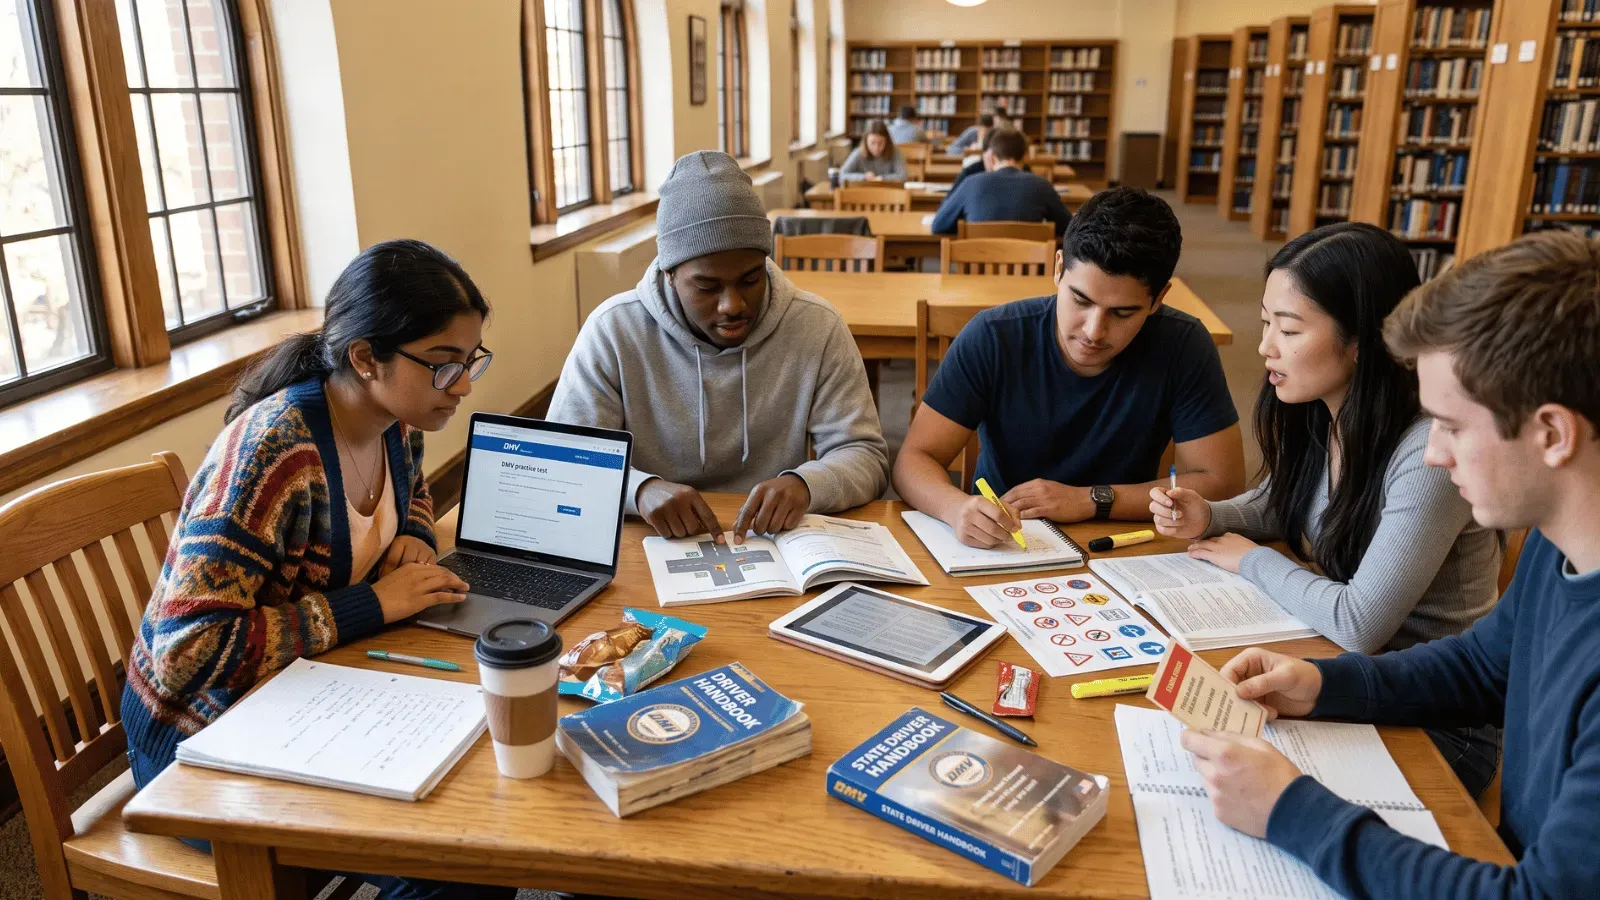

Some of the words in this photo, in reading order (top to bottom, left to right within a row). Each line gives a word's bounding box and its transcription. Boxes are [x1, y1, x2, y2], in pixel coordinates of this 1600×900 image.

[503, 442, 521, 451] DMV
[501, 461, 514, 469] DMV
[514, 464, 536, 473] practice
[692, 677, 763, 730] HANDBOOK
[710, 672, 757, 707] DRIVER
[647, 713, 682, 733] DMV
[851, 743, 890, 772] STATE
[883, 715, 931, 747] DRIVER
[865, 721, 946, 778] HANDBOOK
[946, 757, 974, 782] DMV
[833, 780, 868, 803] DMV
[881, 803, 905, 822] STATE
[905, 815, 936, 835] DRIVER
[936, 829, 987, 860] HANDBOOK
